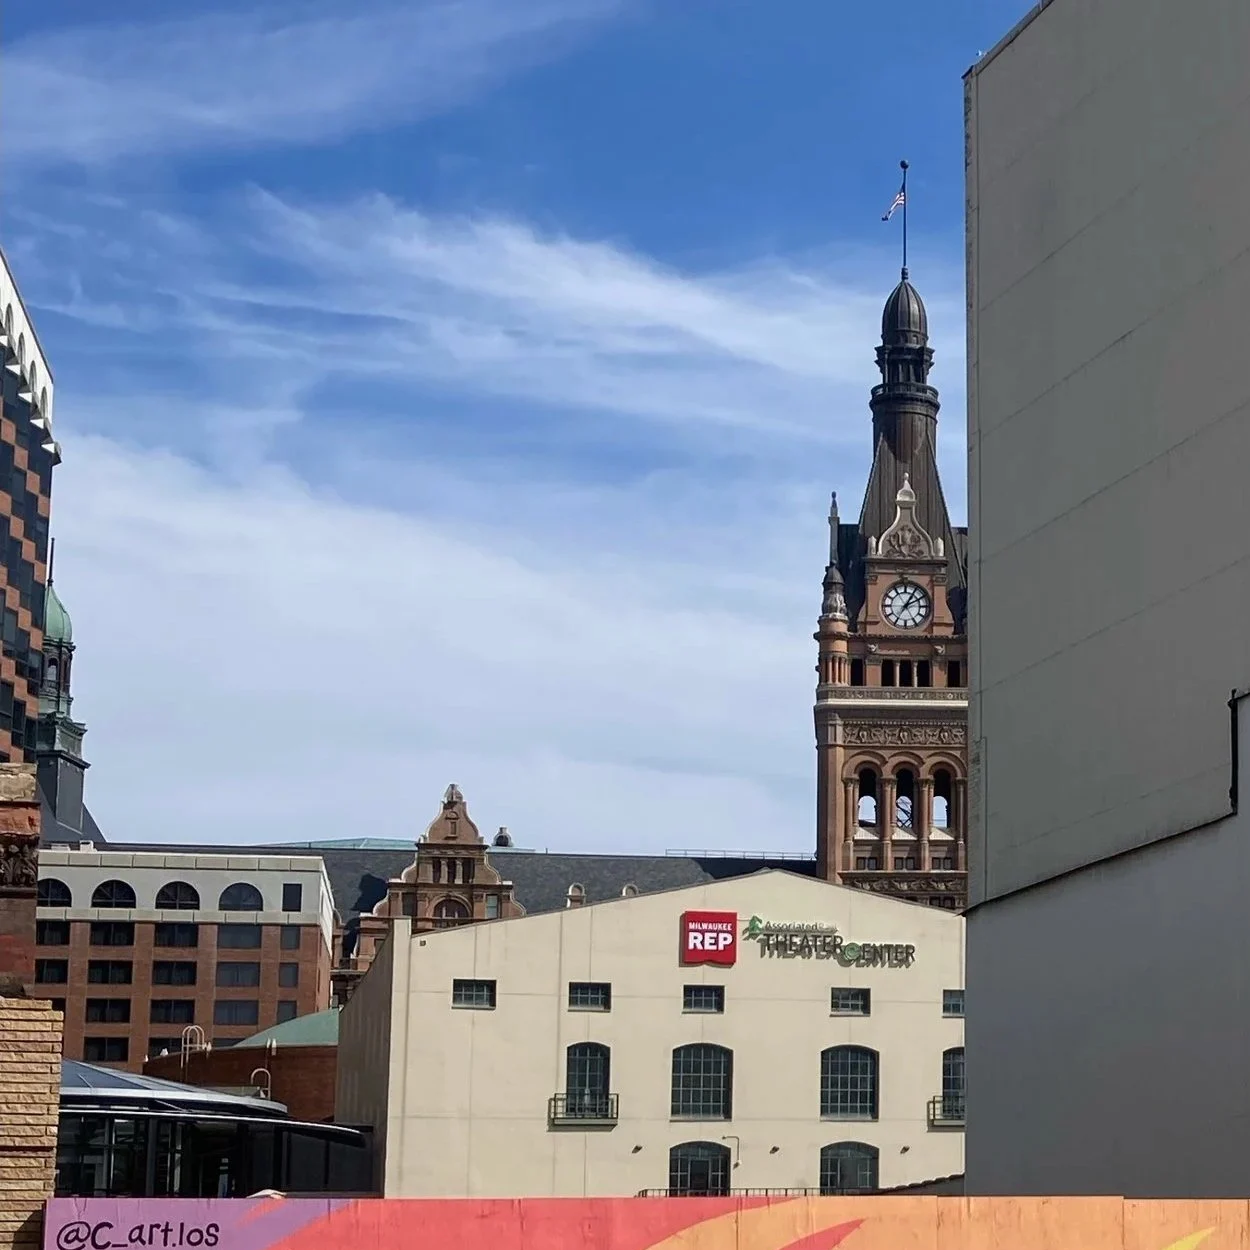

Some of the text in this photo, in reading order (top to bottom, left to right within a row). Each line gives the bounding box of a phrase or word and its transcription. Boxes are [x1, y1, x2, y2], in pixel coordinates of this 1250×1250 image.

[688, 922, 732, 930] MILWAUKEE
[765, 920, 818, 931] Associated
[688, 931, 733, 950] REP
[763, 933, 843, 953] THEATER
